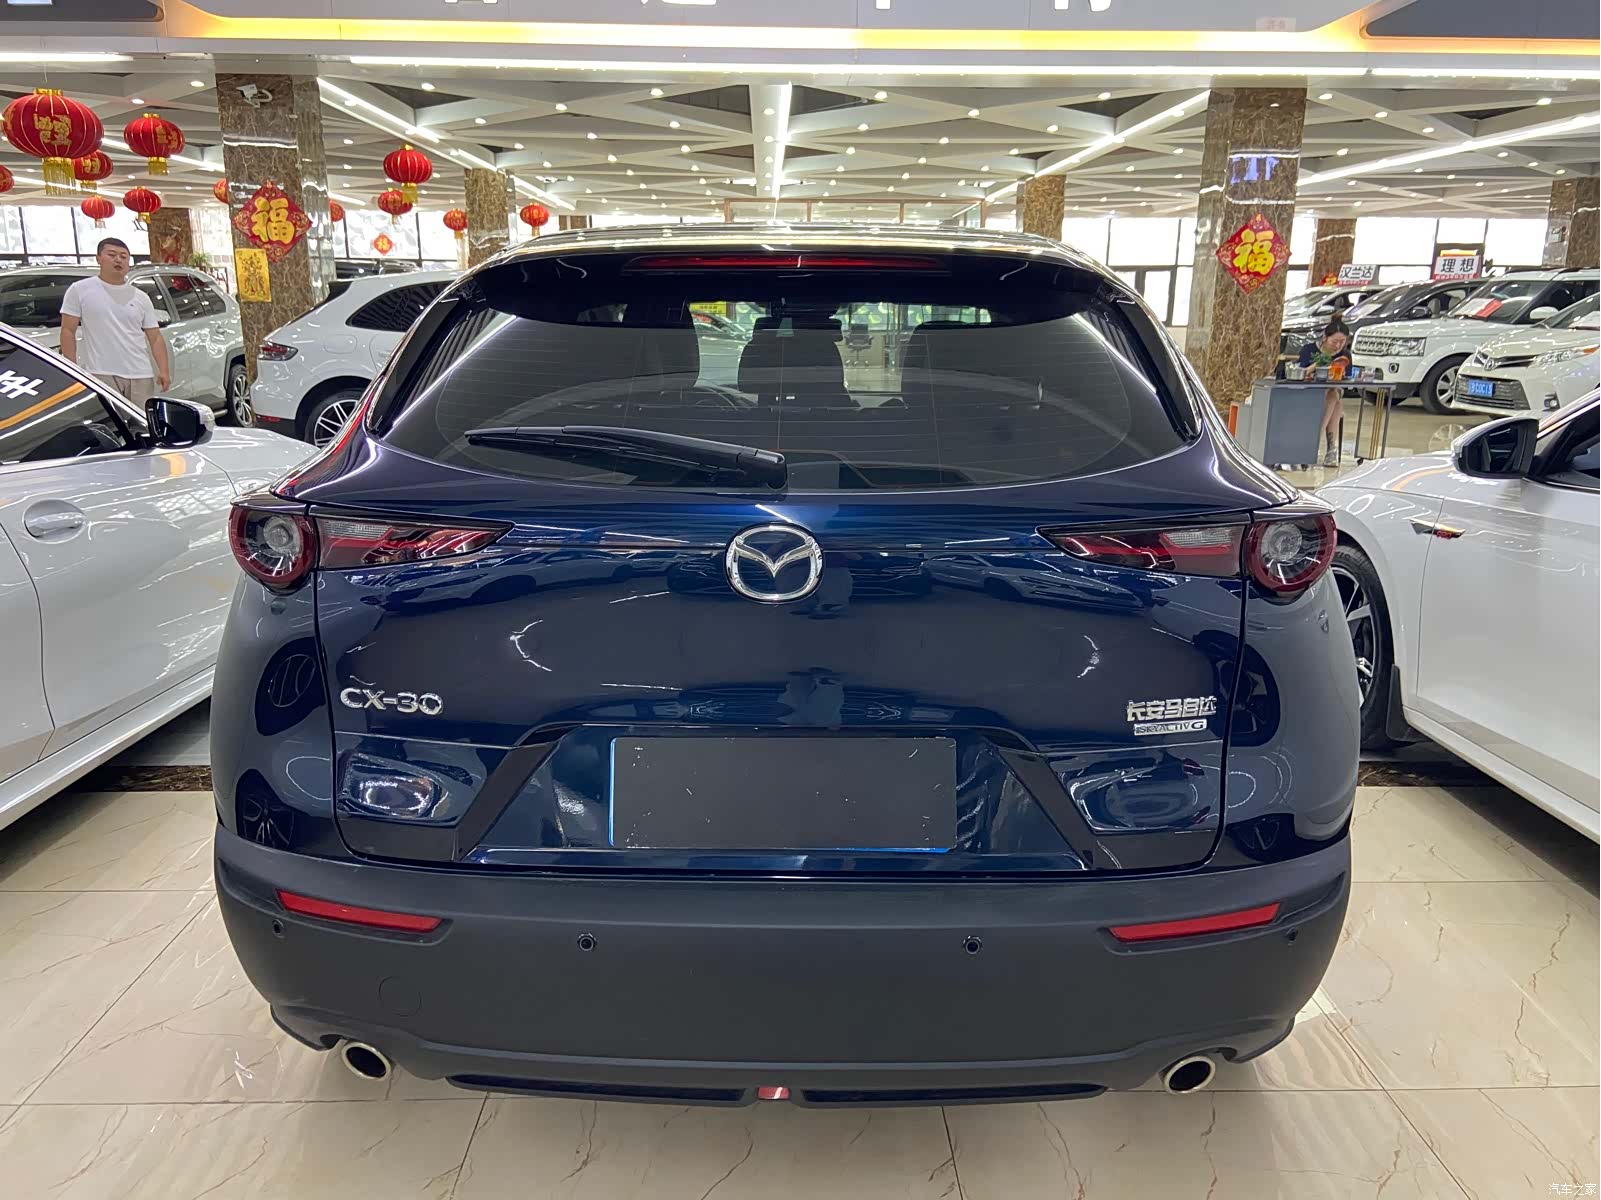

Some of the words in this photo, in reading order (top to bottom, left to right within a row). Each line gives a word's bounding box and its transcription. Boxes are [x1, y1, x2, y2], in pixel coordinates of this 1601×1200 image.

[251, 196, 295, 244] 福
[1232, 228, 1275, 275] 福
[1339, 265, 1374, 280] 汉兰达
[1440, 258, 1475, 273] 理想
[340, 687, 443, 715] CX-30
[1127, 696, 1218, 721] 长安马自达
